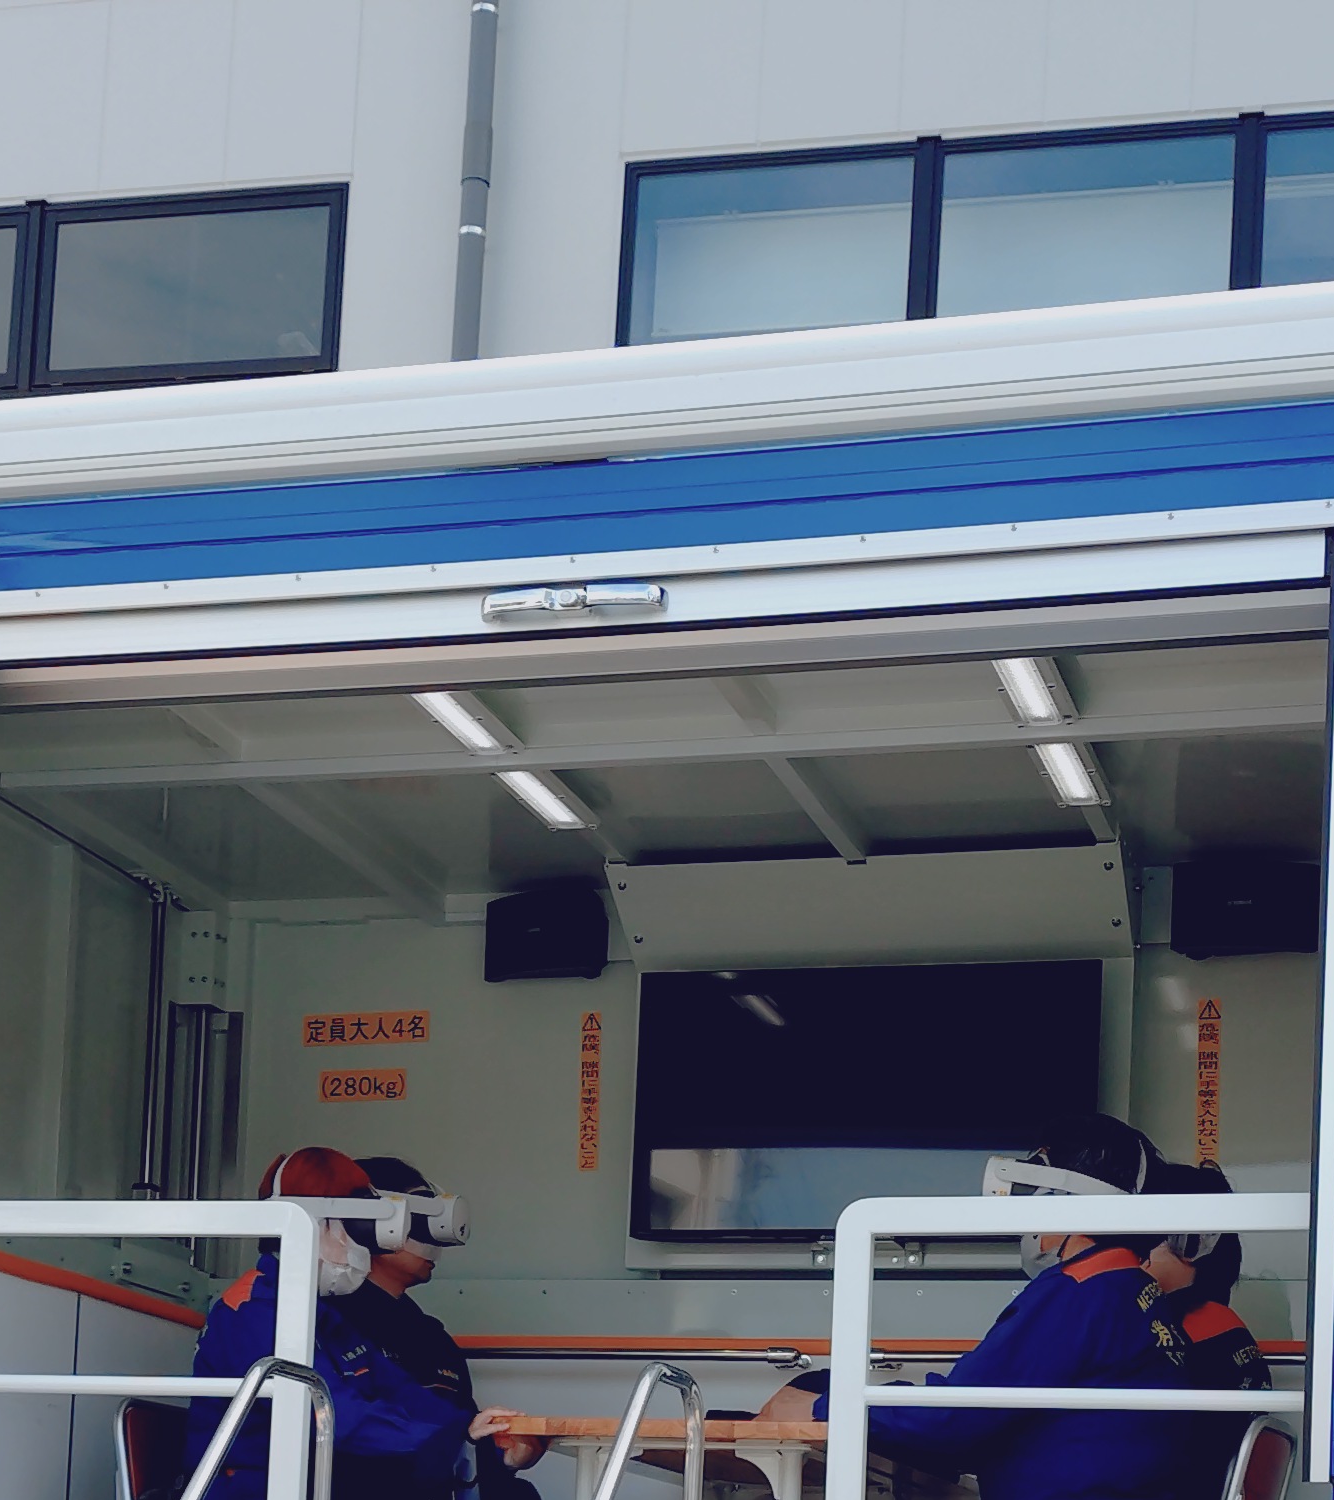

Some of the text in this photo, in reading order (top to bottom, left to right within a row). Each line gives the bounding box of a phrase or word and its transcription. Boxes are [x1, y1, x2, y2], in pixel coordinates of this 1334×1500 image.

[305, 1014, 426, 1043] 定員大人4名
[321, 1073, 405, 1099] (280kg)
